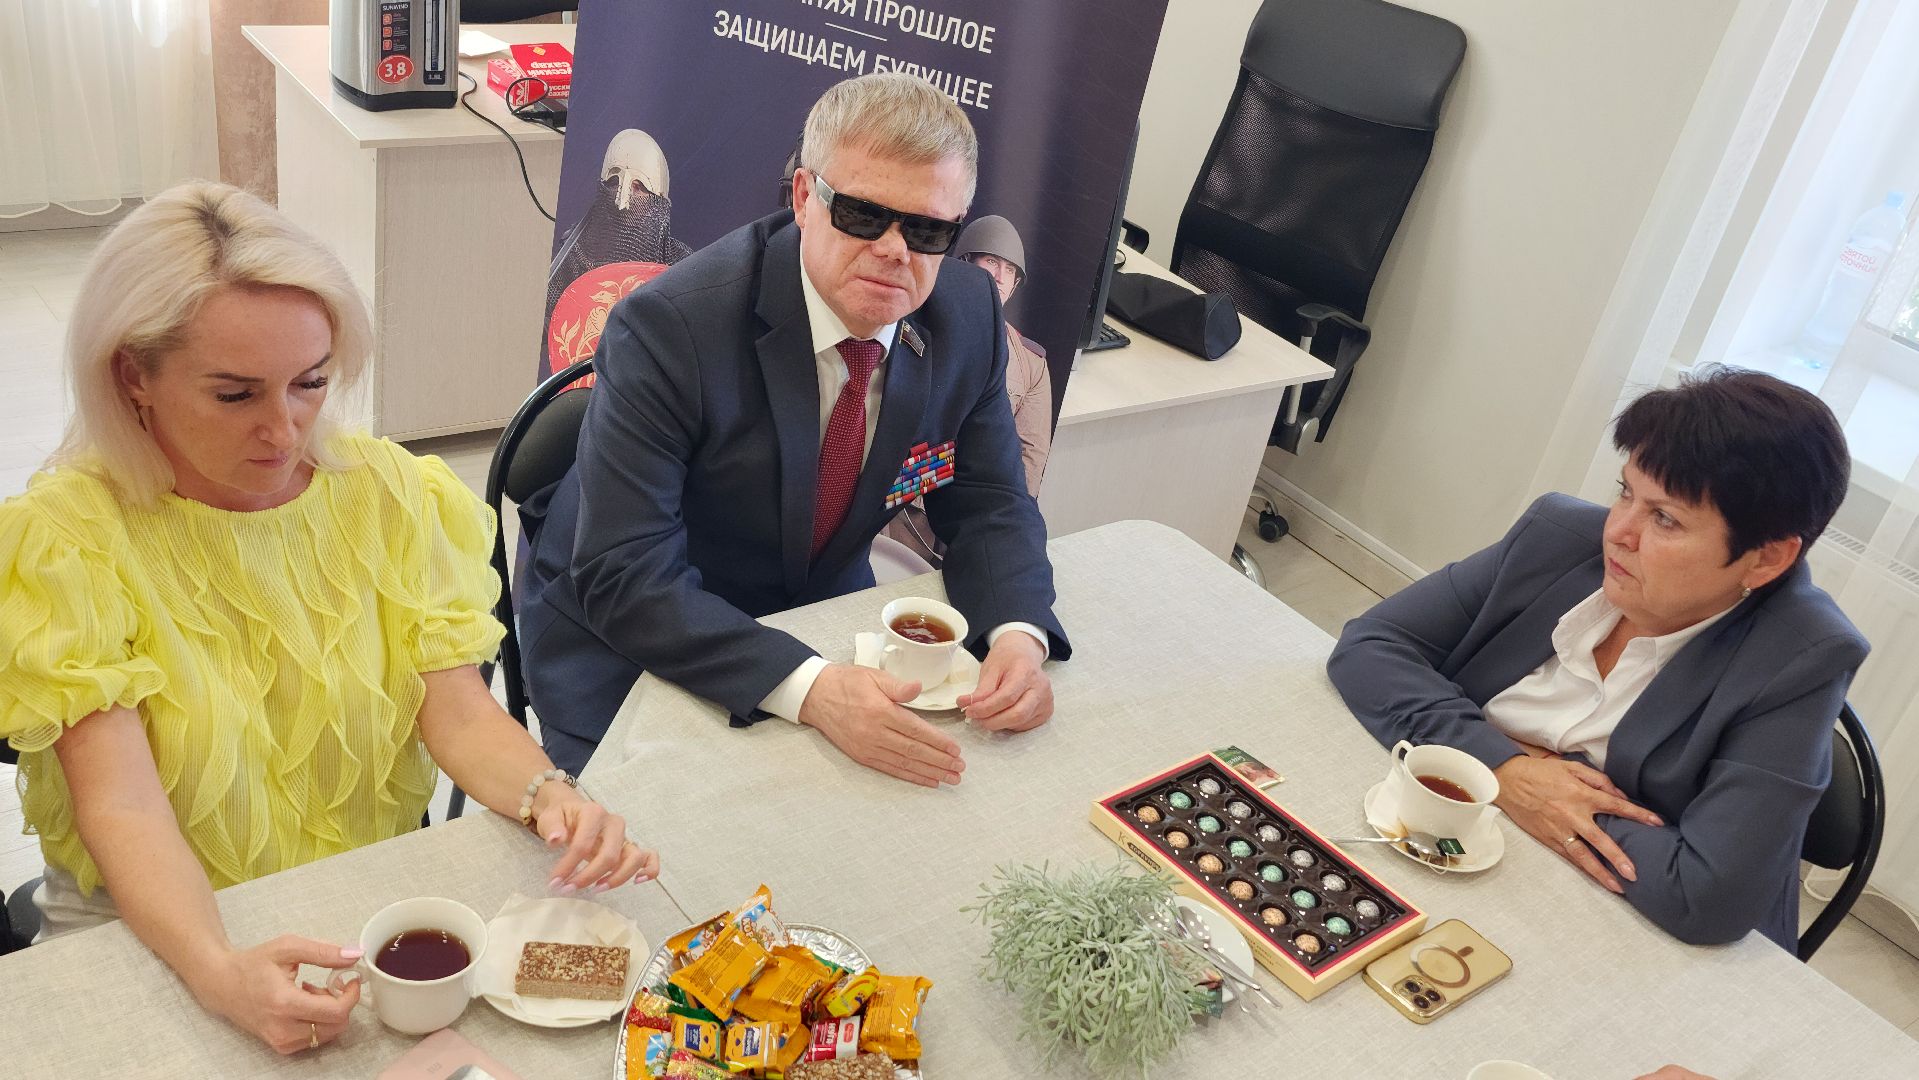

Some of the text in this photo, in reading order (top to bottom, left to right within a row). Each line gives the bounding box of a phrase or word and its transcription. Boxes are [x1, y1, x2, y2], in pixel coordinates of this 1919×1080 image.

[713, 9, 866, 75] ЗАЩИЩАЕМ
[864, 0, 996, 54] ПРОШЛОЕ
[384, 61, 407, 79] 3,8
